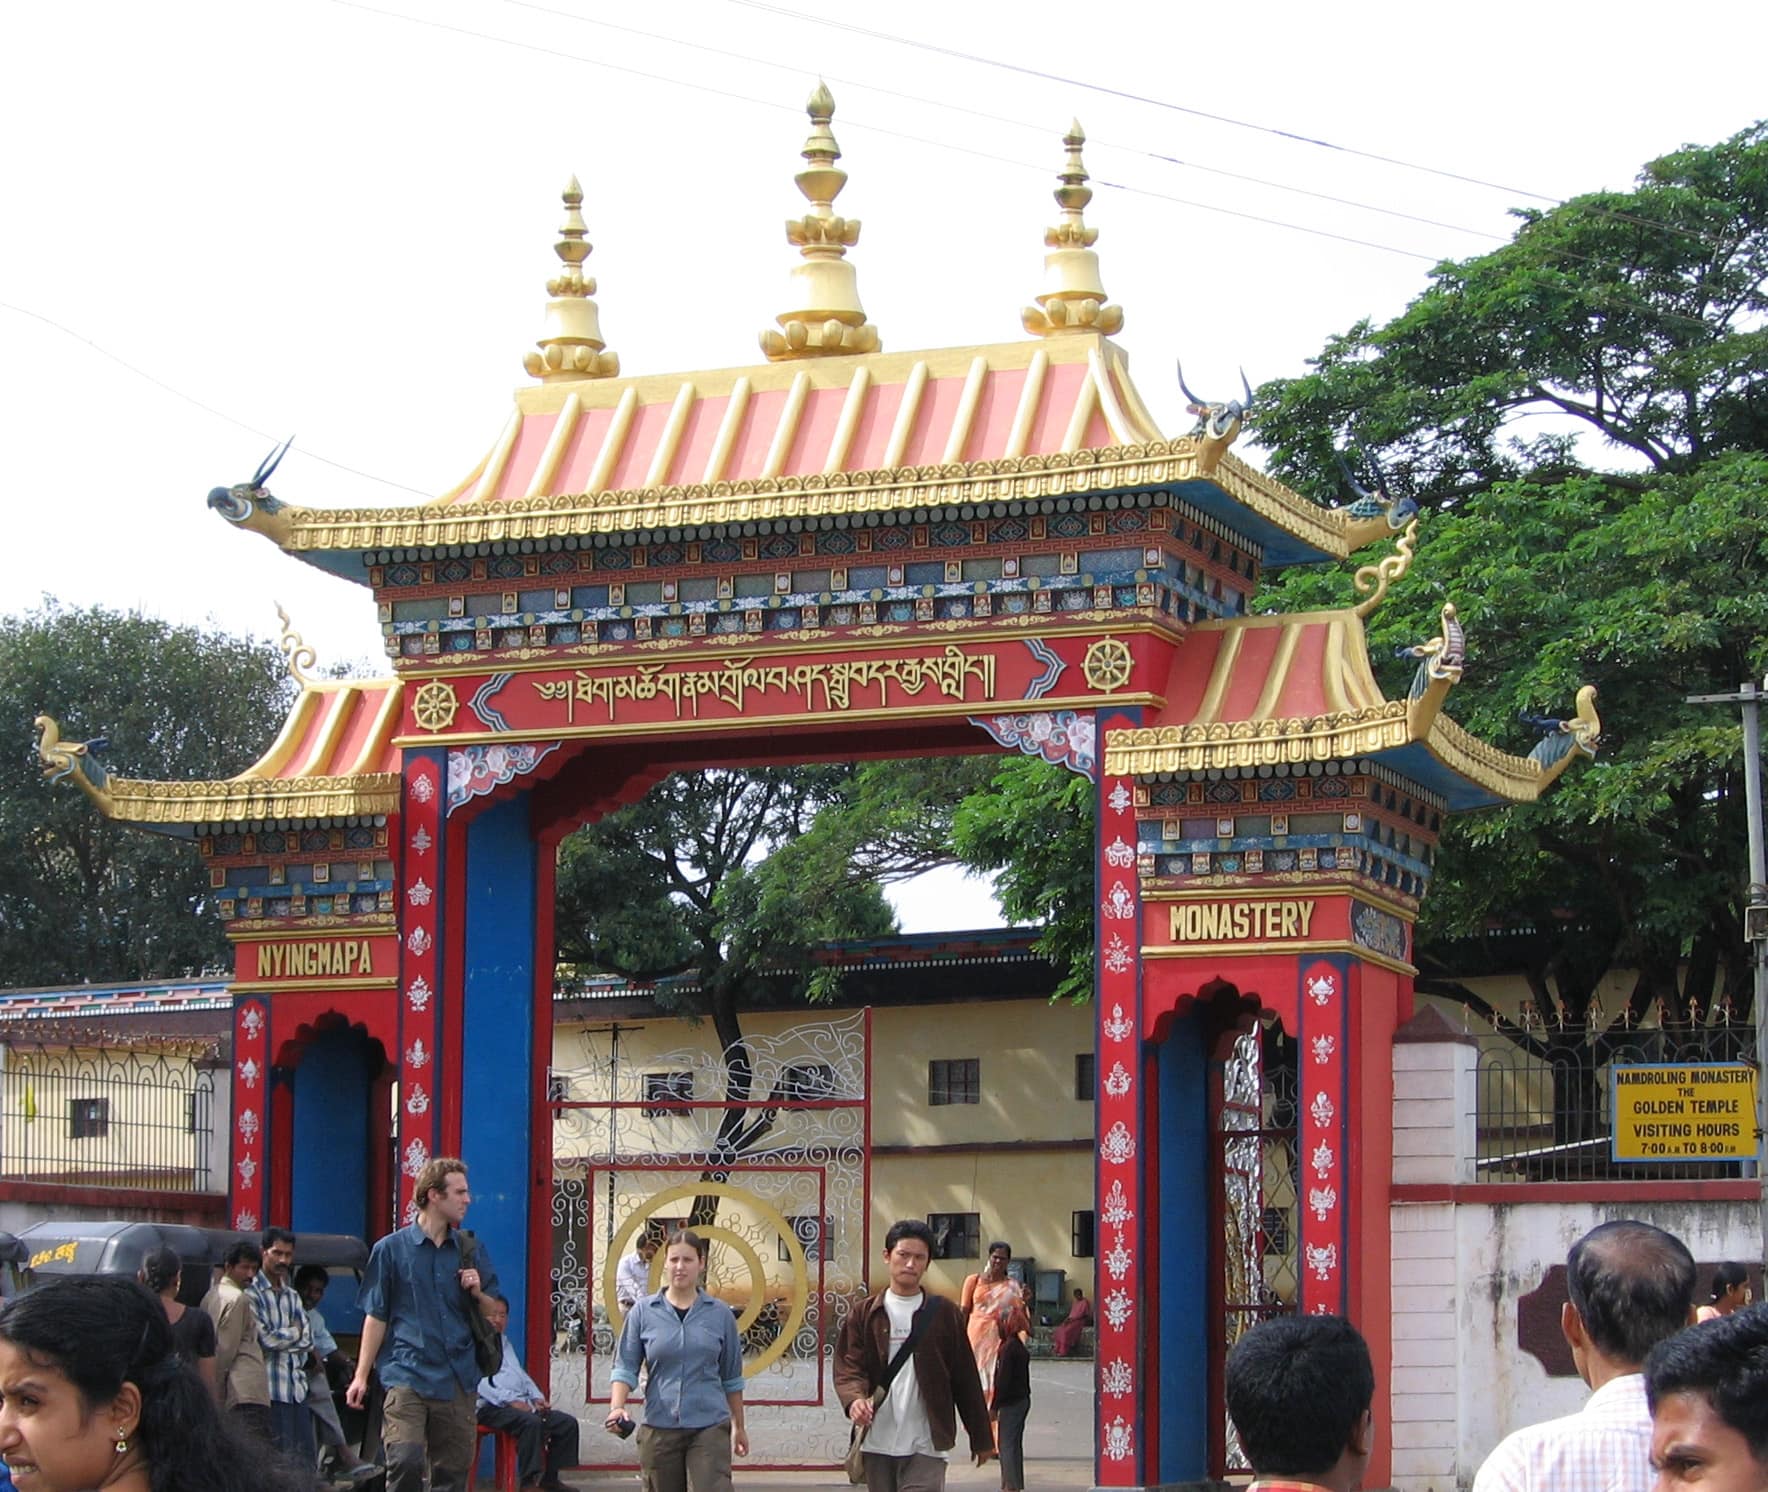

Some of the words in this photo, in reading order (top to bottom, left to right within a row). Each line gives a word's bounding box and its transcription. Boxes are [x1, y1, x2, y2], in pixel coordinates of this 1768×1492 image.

[1170, 900, 1315, 941] MONASTERY
[258, 940, 372, 977] NYINGMAPA
[1617, 1071, 1686, 1085] NAMDROLING
[1691, 1070, 1754, 1084] MONASTERY
[1677, 1087, 1695, 1097] THE
[1633, 1101, 1684, 1114] GOLDEN
[1690, 1099, 1739, 1113] TEMPLE
[1633, 1124, 1692, 1138] VISITING
[1696, 1123, 1740, 1137] HOURS
[1683, 1142, 1697, 1154] TO
